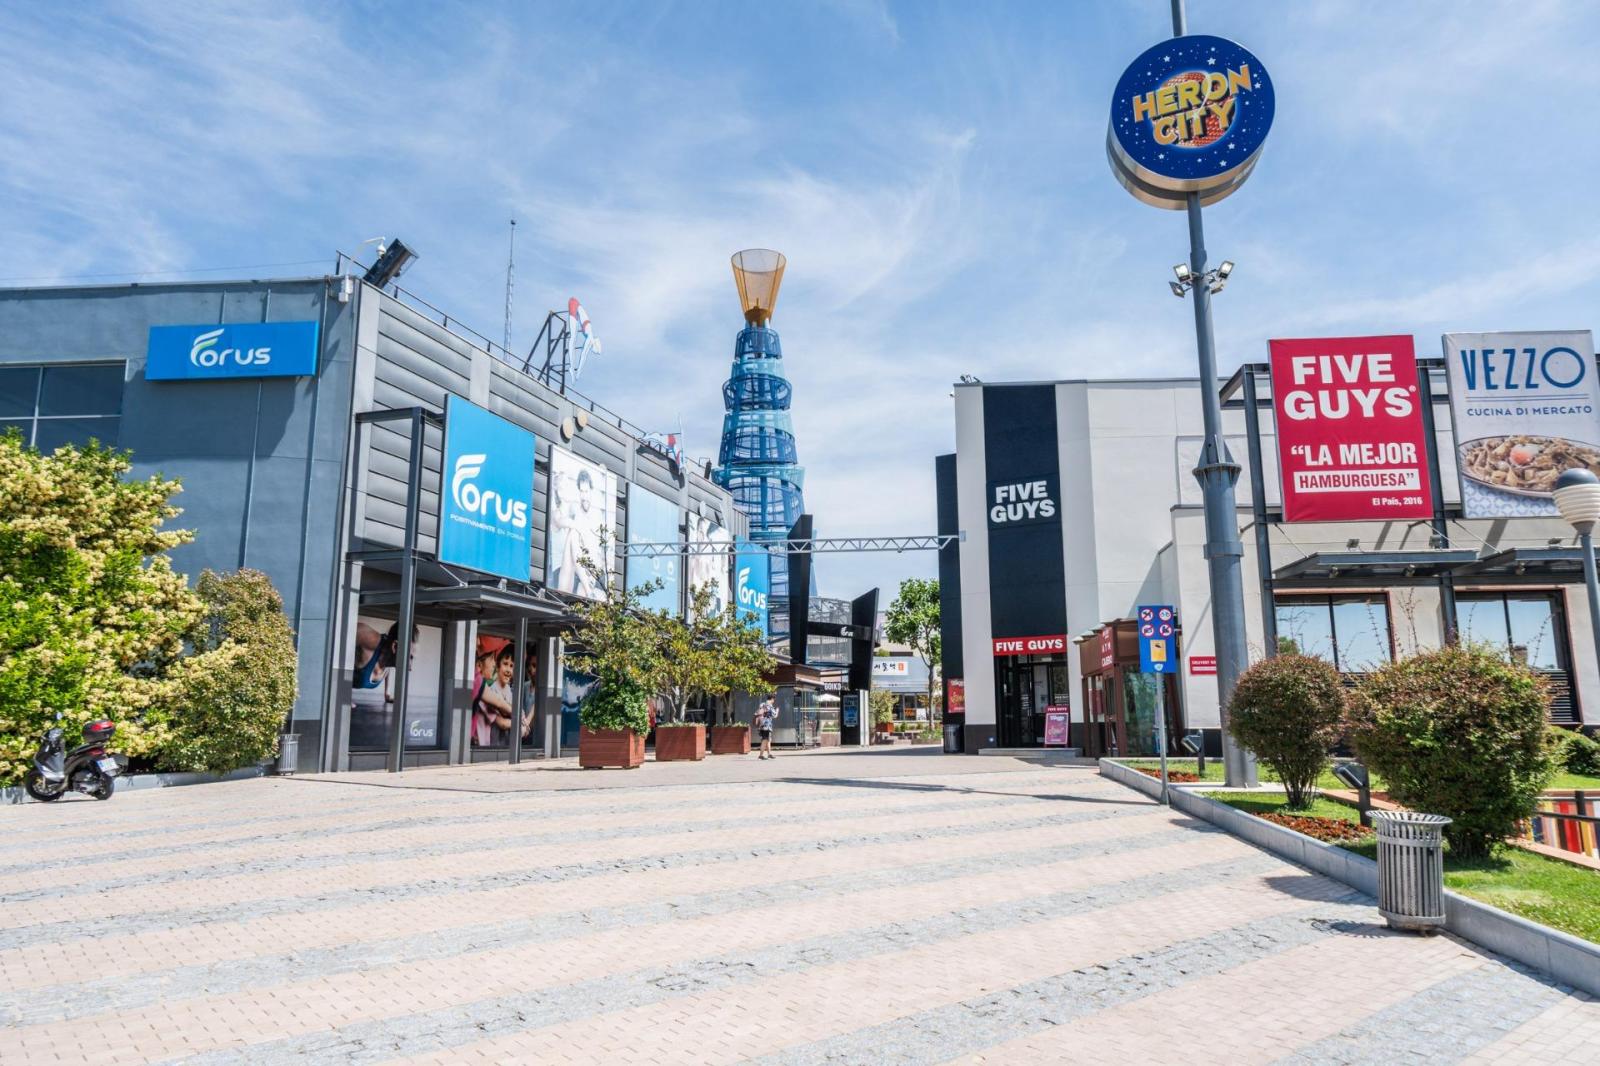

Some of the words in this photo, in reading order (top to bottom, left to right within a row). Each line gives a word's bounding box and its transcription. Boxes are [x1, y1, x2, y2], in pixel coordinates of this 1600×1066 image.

[1132, 64, 1252, 123] HERON
[1153, 97, 1236, 145] CITY
[190, 328, 271, 367] Forus
[1292, 353, 1396, 385] FIVE
[1460, 347, 1585, 390] VEZZO
[1467, 407, 1513, 417] CUCINA
[1516, 406, 1529, 416] DI
[1533, 404, 1593, 415] MERCATO
[1339, 442, 1418, 466] MEJOR
[995, 480, 1048, 503] FIVE
[1299, 472, 1415, 489] HAMBURGUESA”
[990, 499, 1056, 523] GUYS
[1372, 497, 1380, 506] El
[1403, 496, 1424, 505] 2016
[995, 641, 1024, 652] FIVE
[1028, 638, 1064, 651] GUYS
